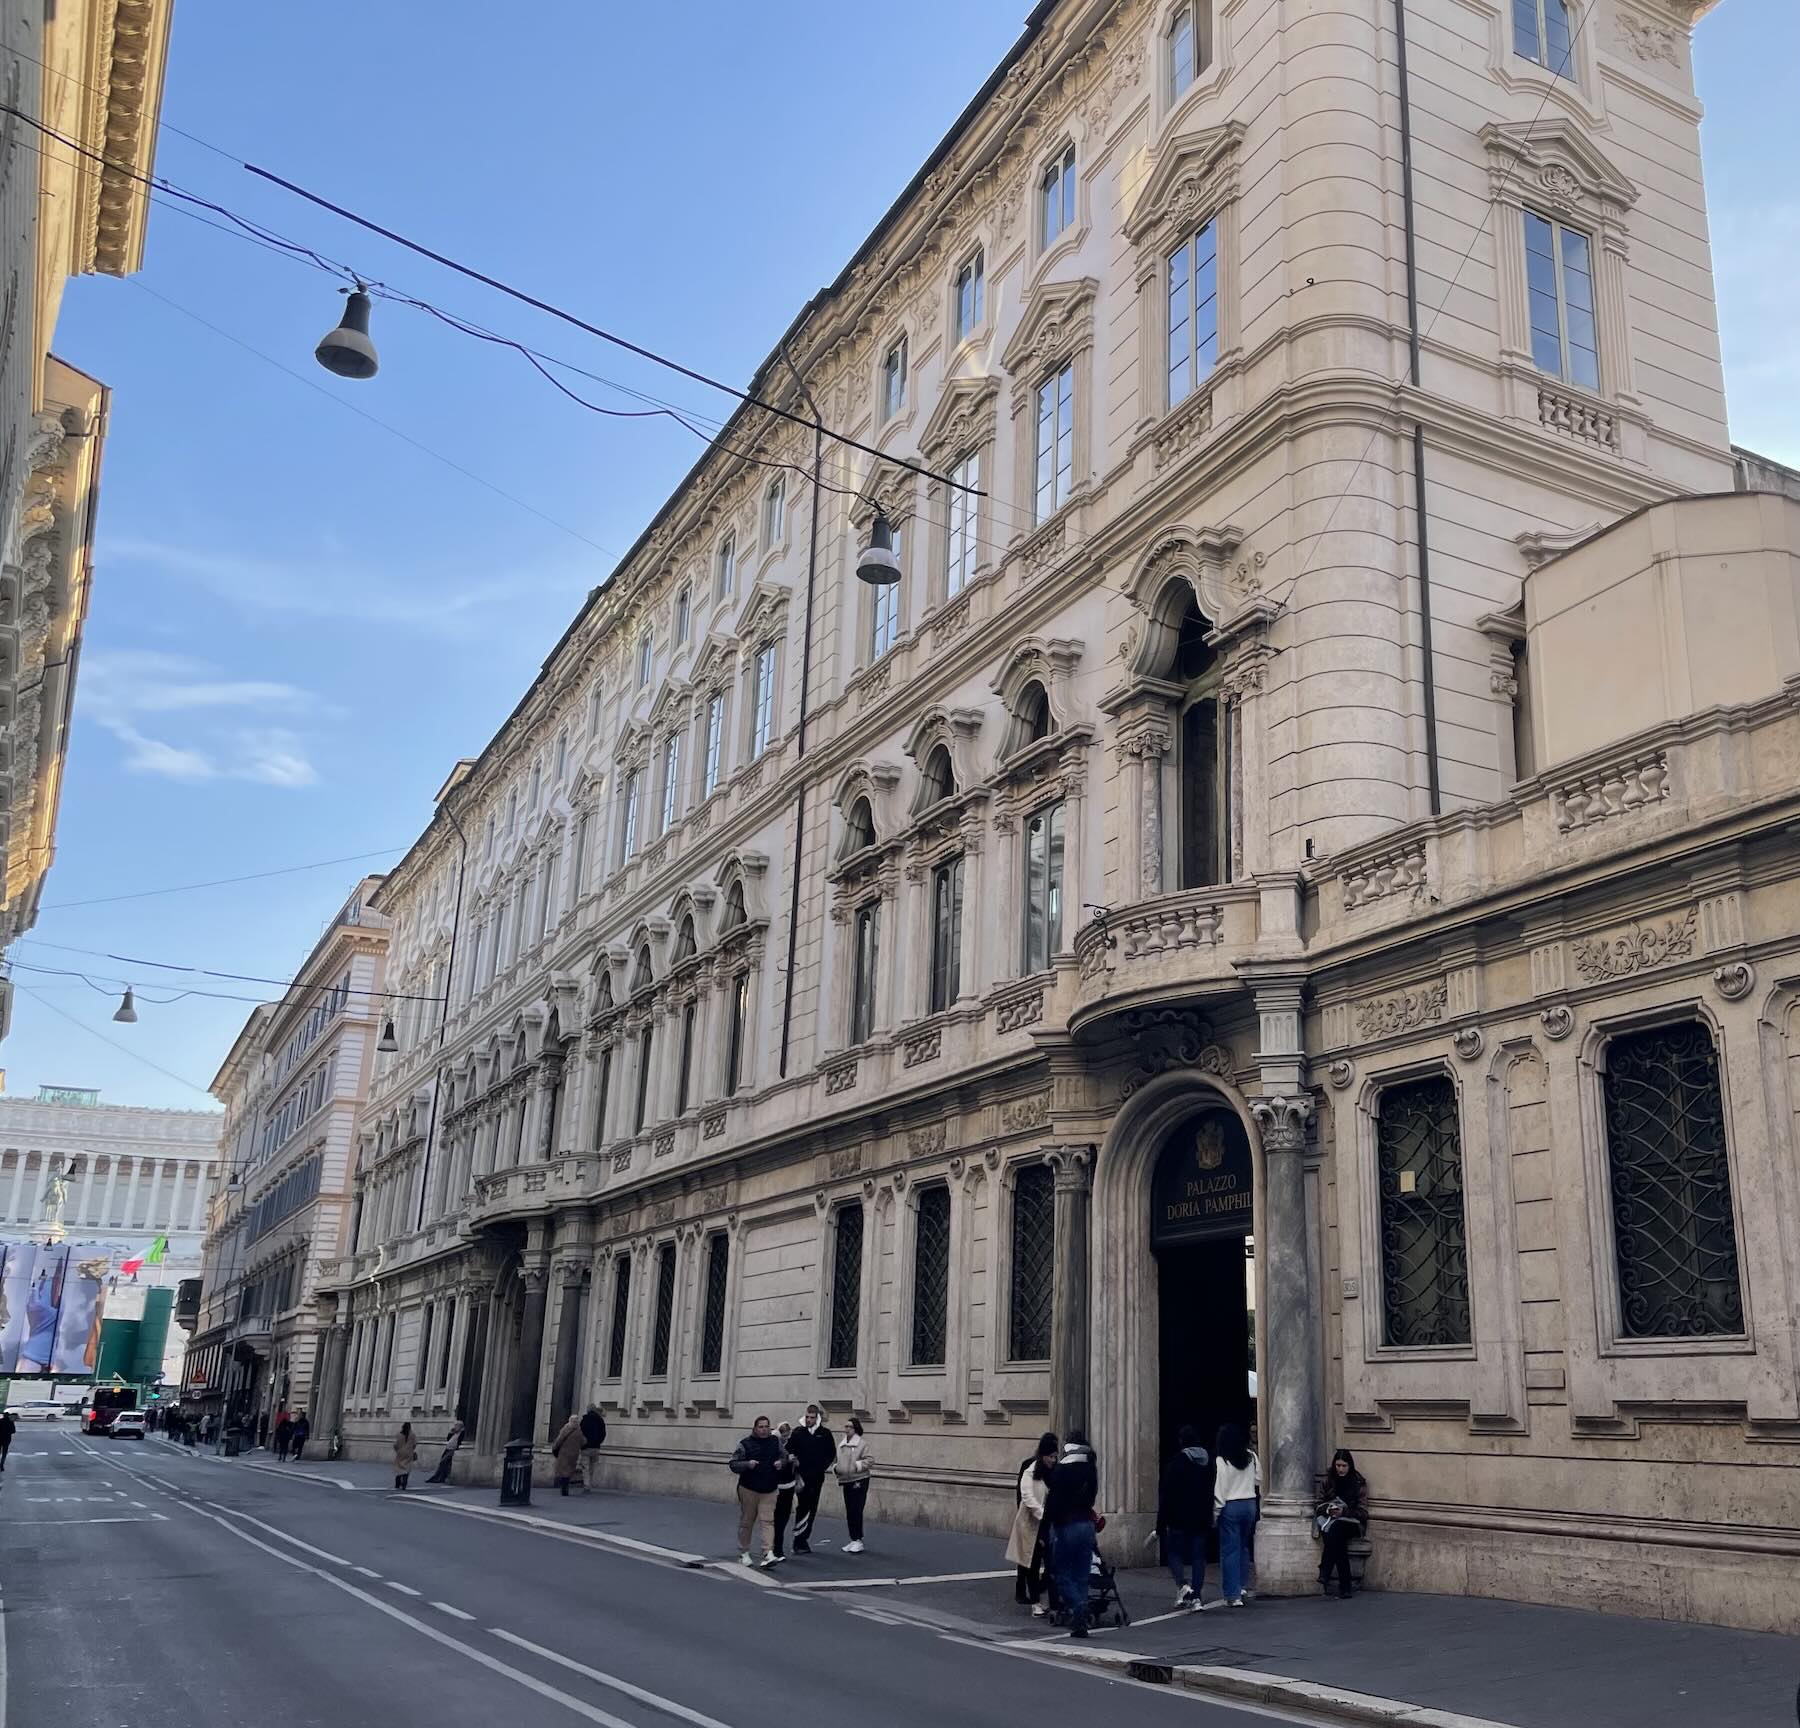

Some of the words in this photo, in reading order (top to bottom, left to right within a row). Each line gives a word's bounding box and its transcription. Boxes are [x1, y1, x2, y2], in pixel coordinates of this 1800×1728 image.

[1186, 1174, 1237, 1196] PALAZZO
[1167, 1201, 1201, 1220] DORIA
[1205, 1192, 1252, 1214] PAMPHIL
